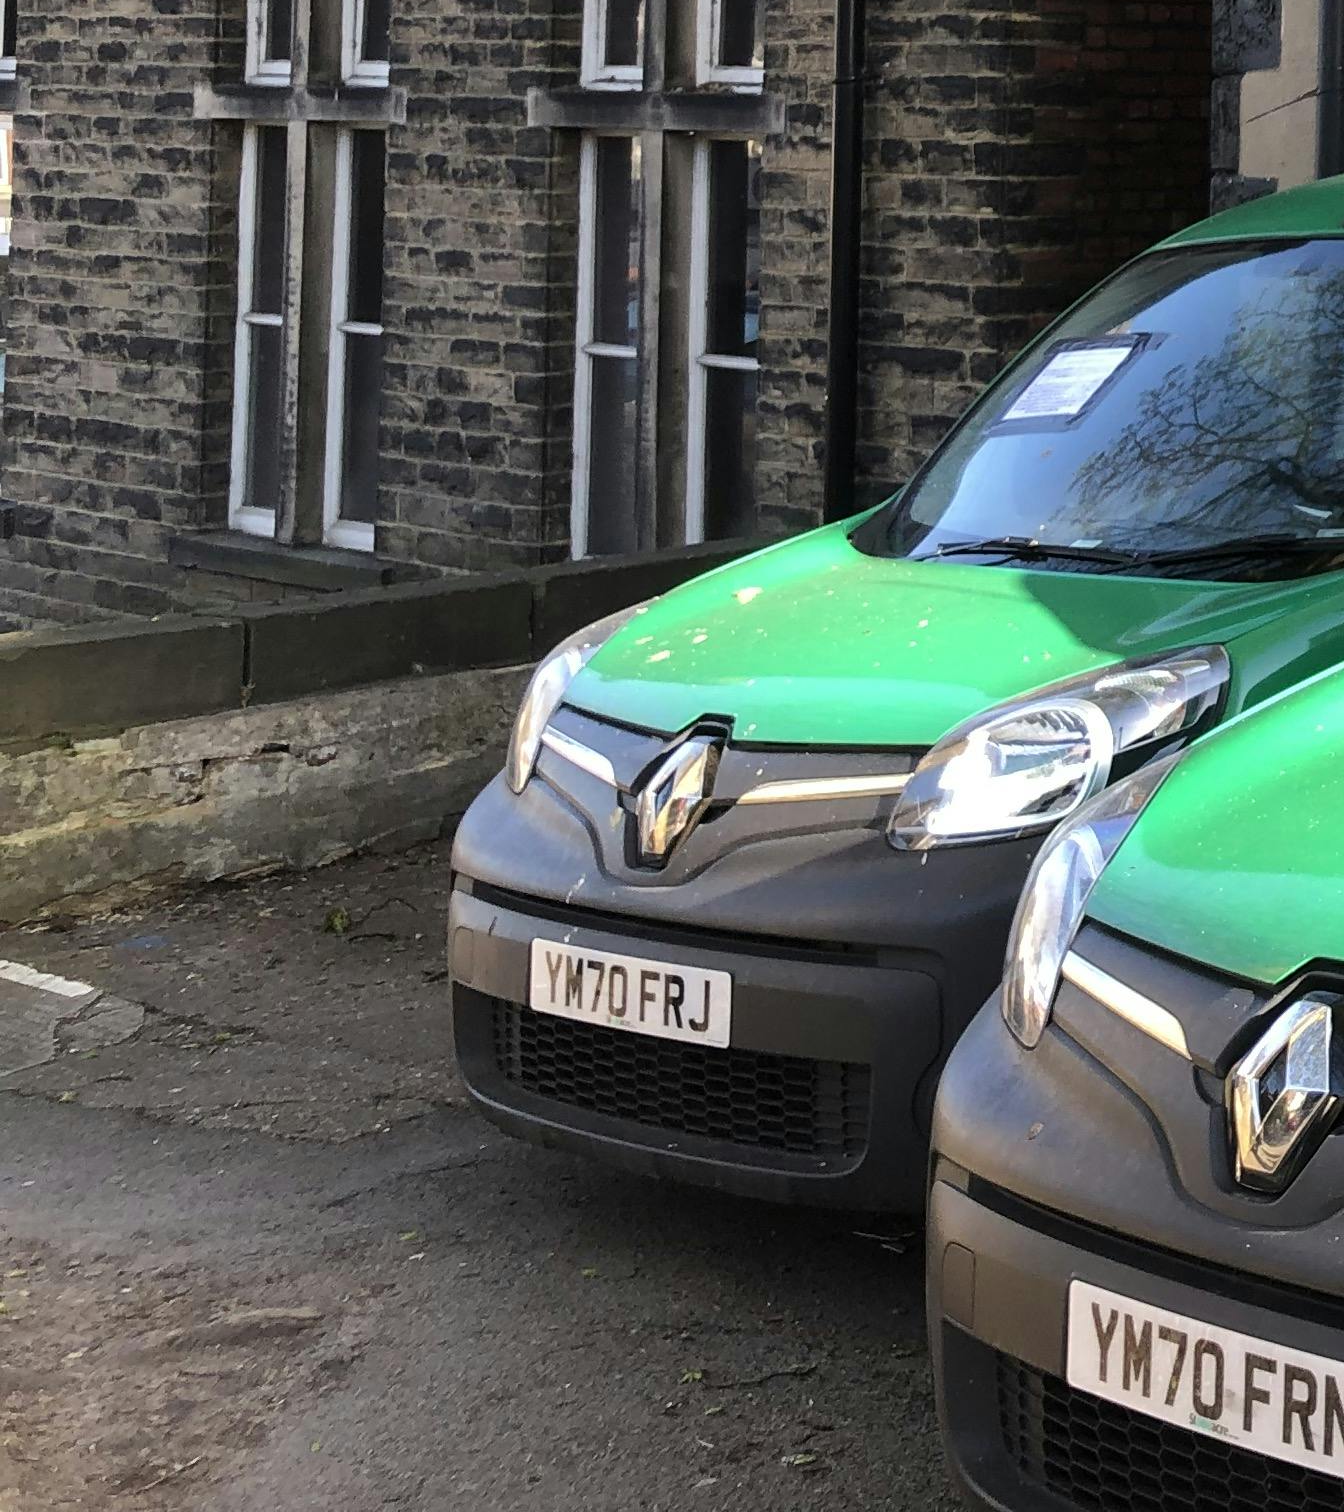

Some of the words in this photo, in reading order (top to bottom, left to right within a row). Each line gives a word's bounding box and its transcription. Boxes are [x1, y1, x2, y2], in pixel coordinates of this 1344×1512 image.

[545, 950, 628, 1018] YM70
[639, 970, 711, 1032] FRJ
[1091, 1301, 1225, 1421] YM70
